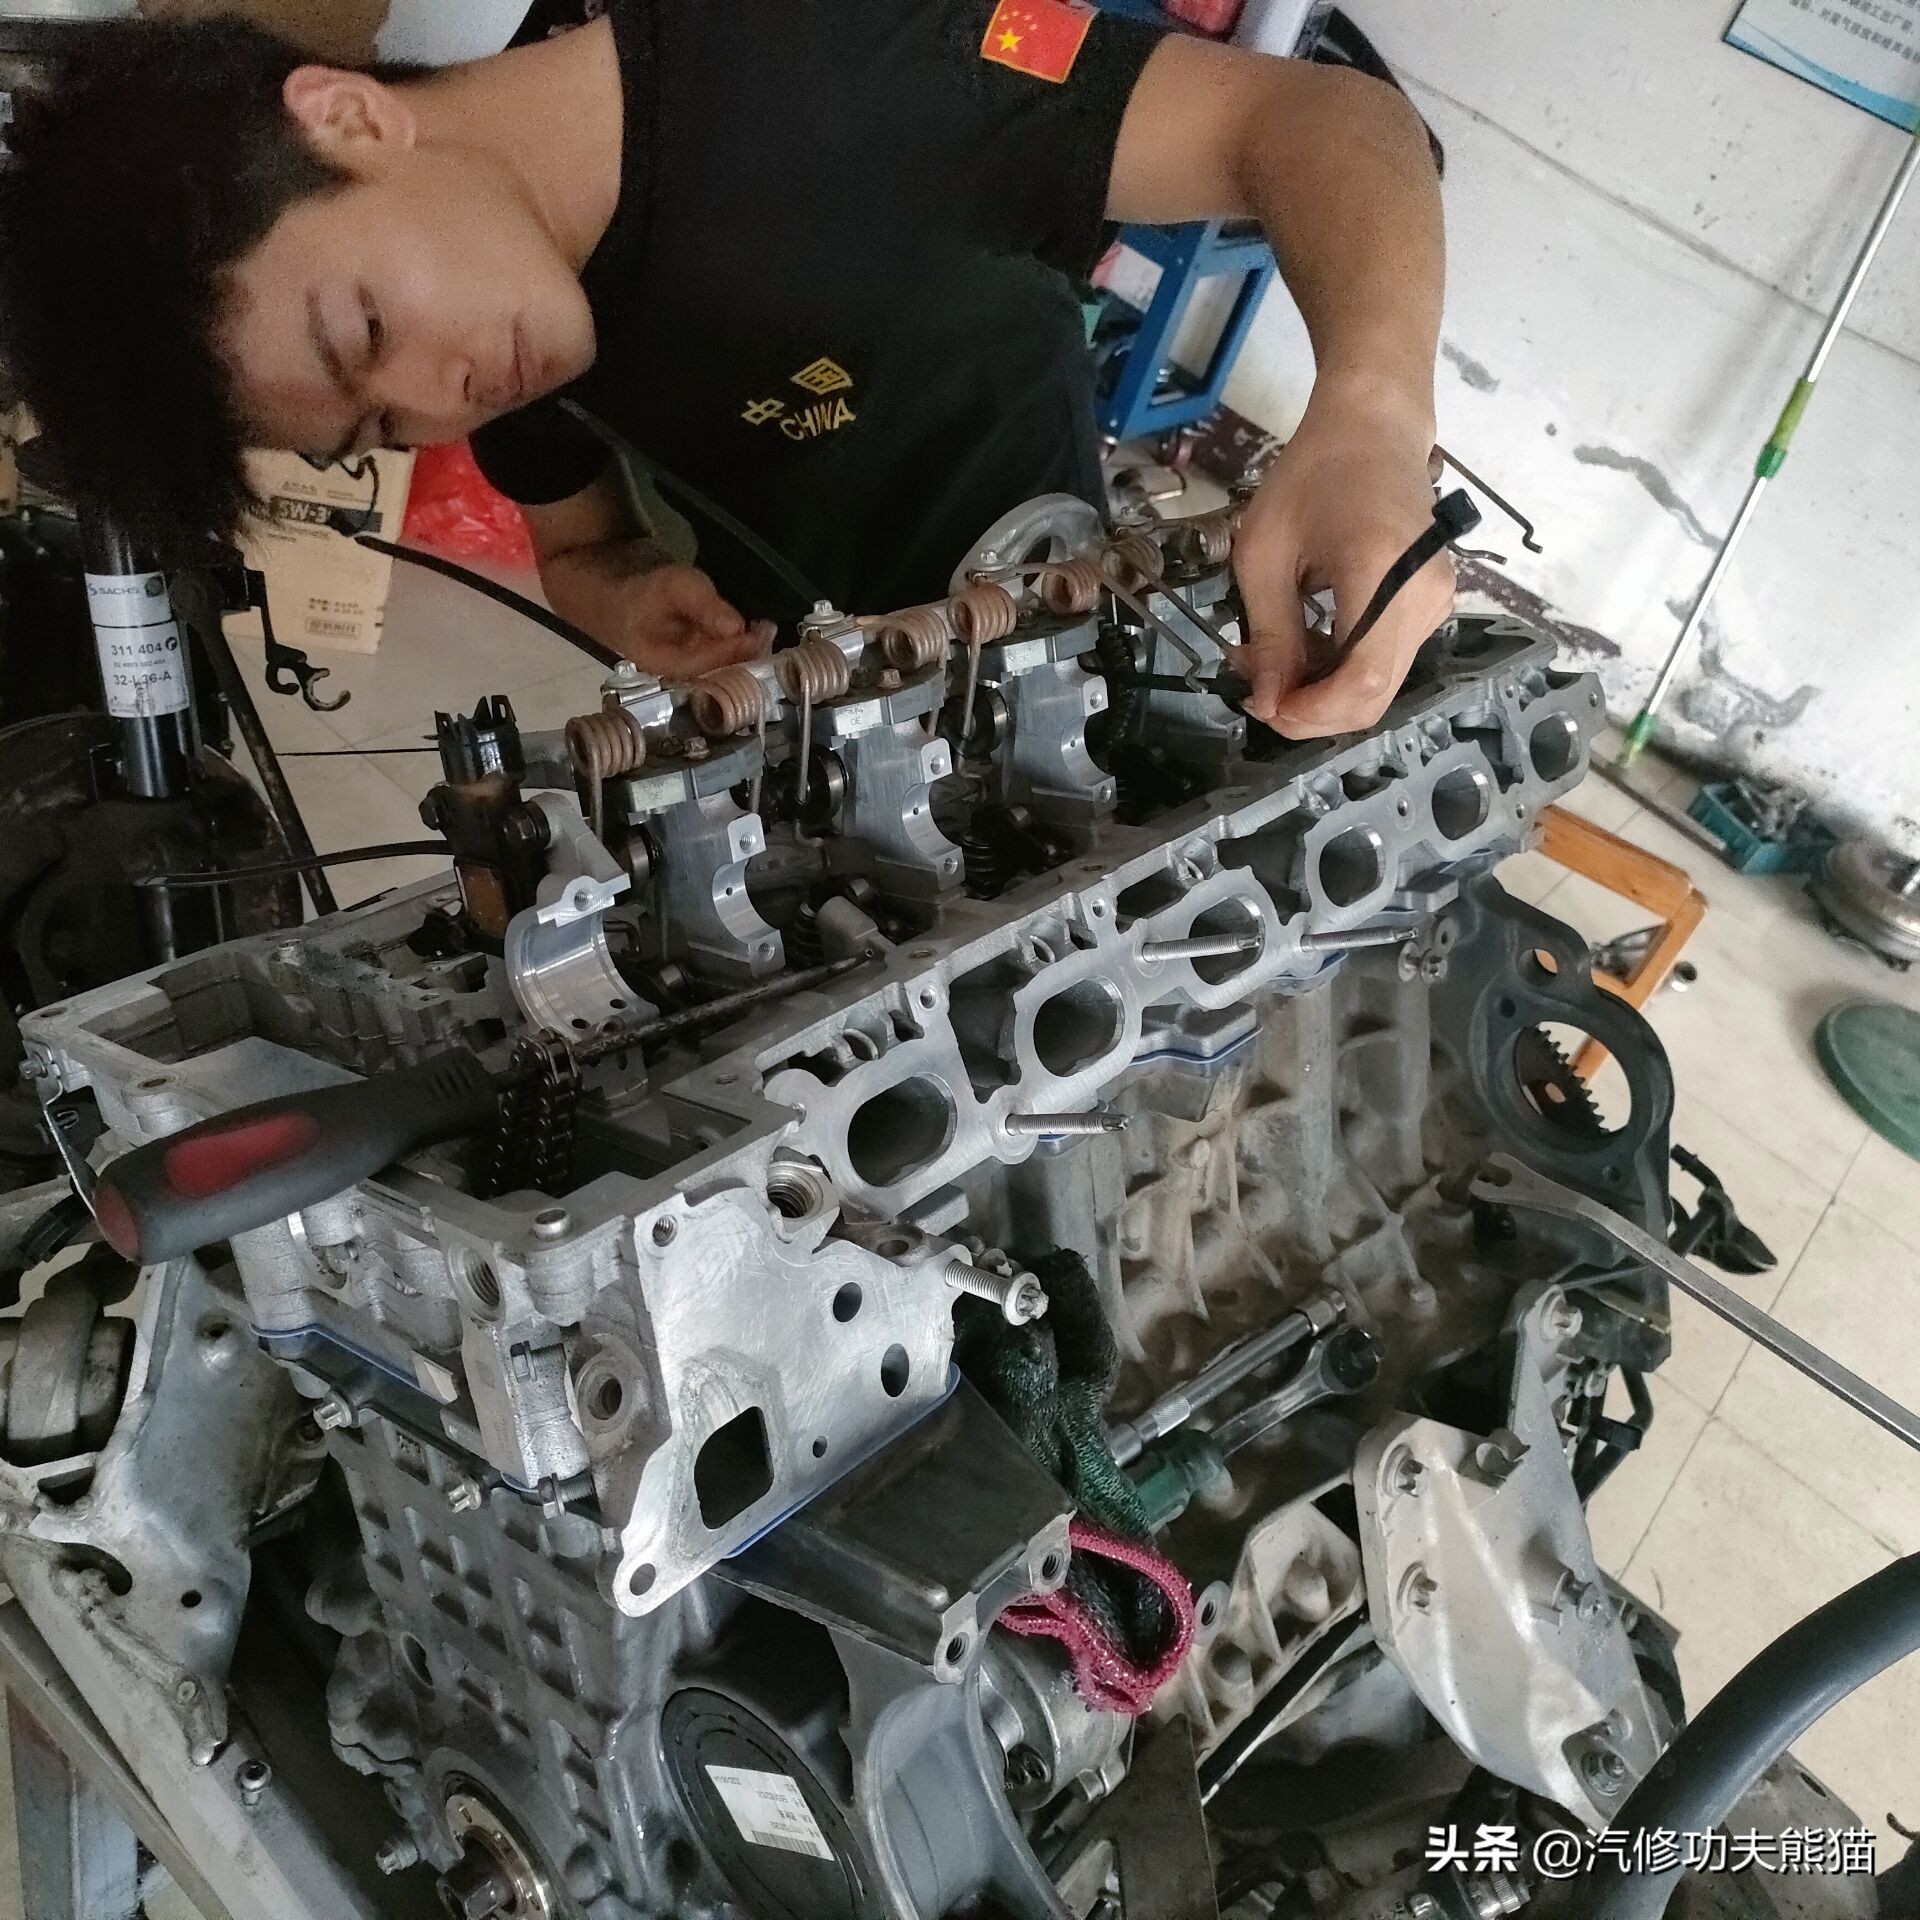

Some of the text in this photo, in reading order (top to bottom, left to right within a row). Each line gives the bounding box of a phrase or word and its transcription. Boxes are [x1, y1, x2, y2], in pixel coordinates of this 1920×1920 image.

[741, 357, 854, 426] 中国
[780, 398, 857, 440] CHINA
[100, 584, 141, 596] SACHS
[111, 643, 162, 656] 311 404
